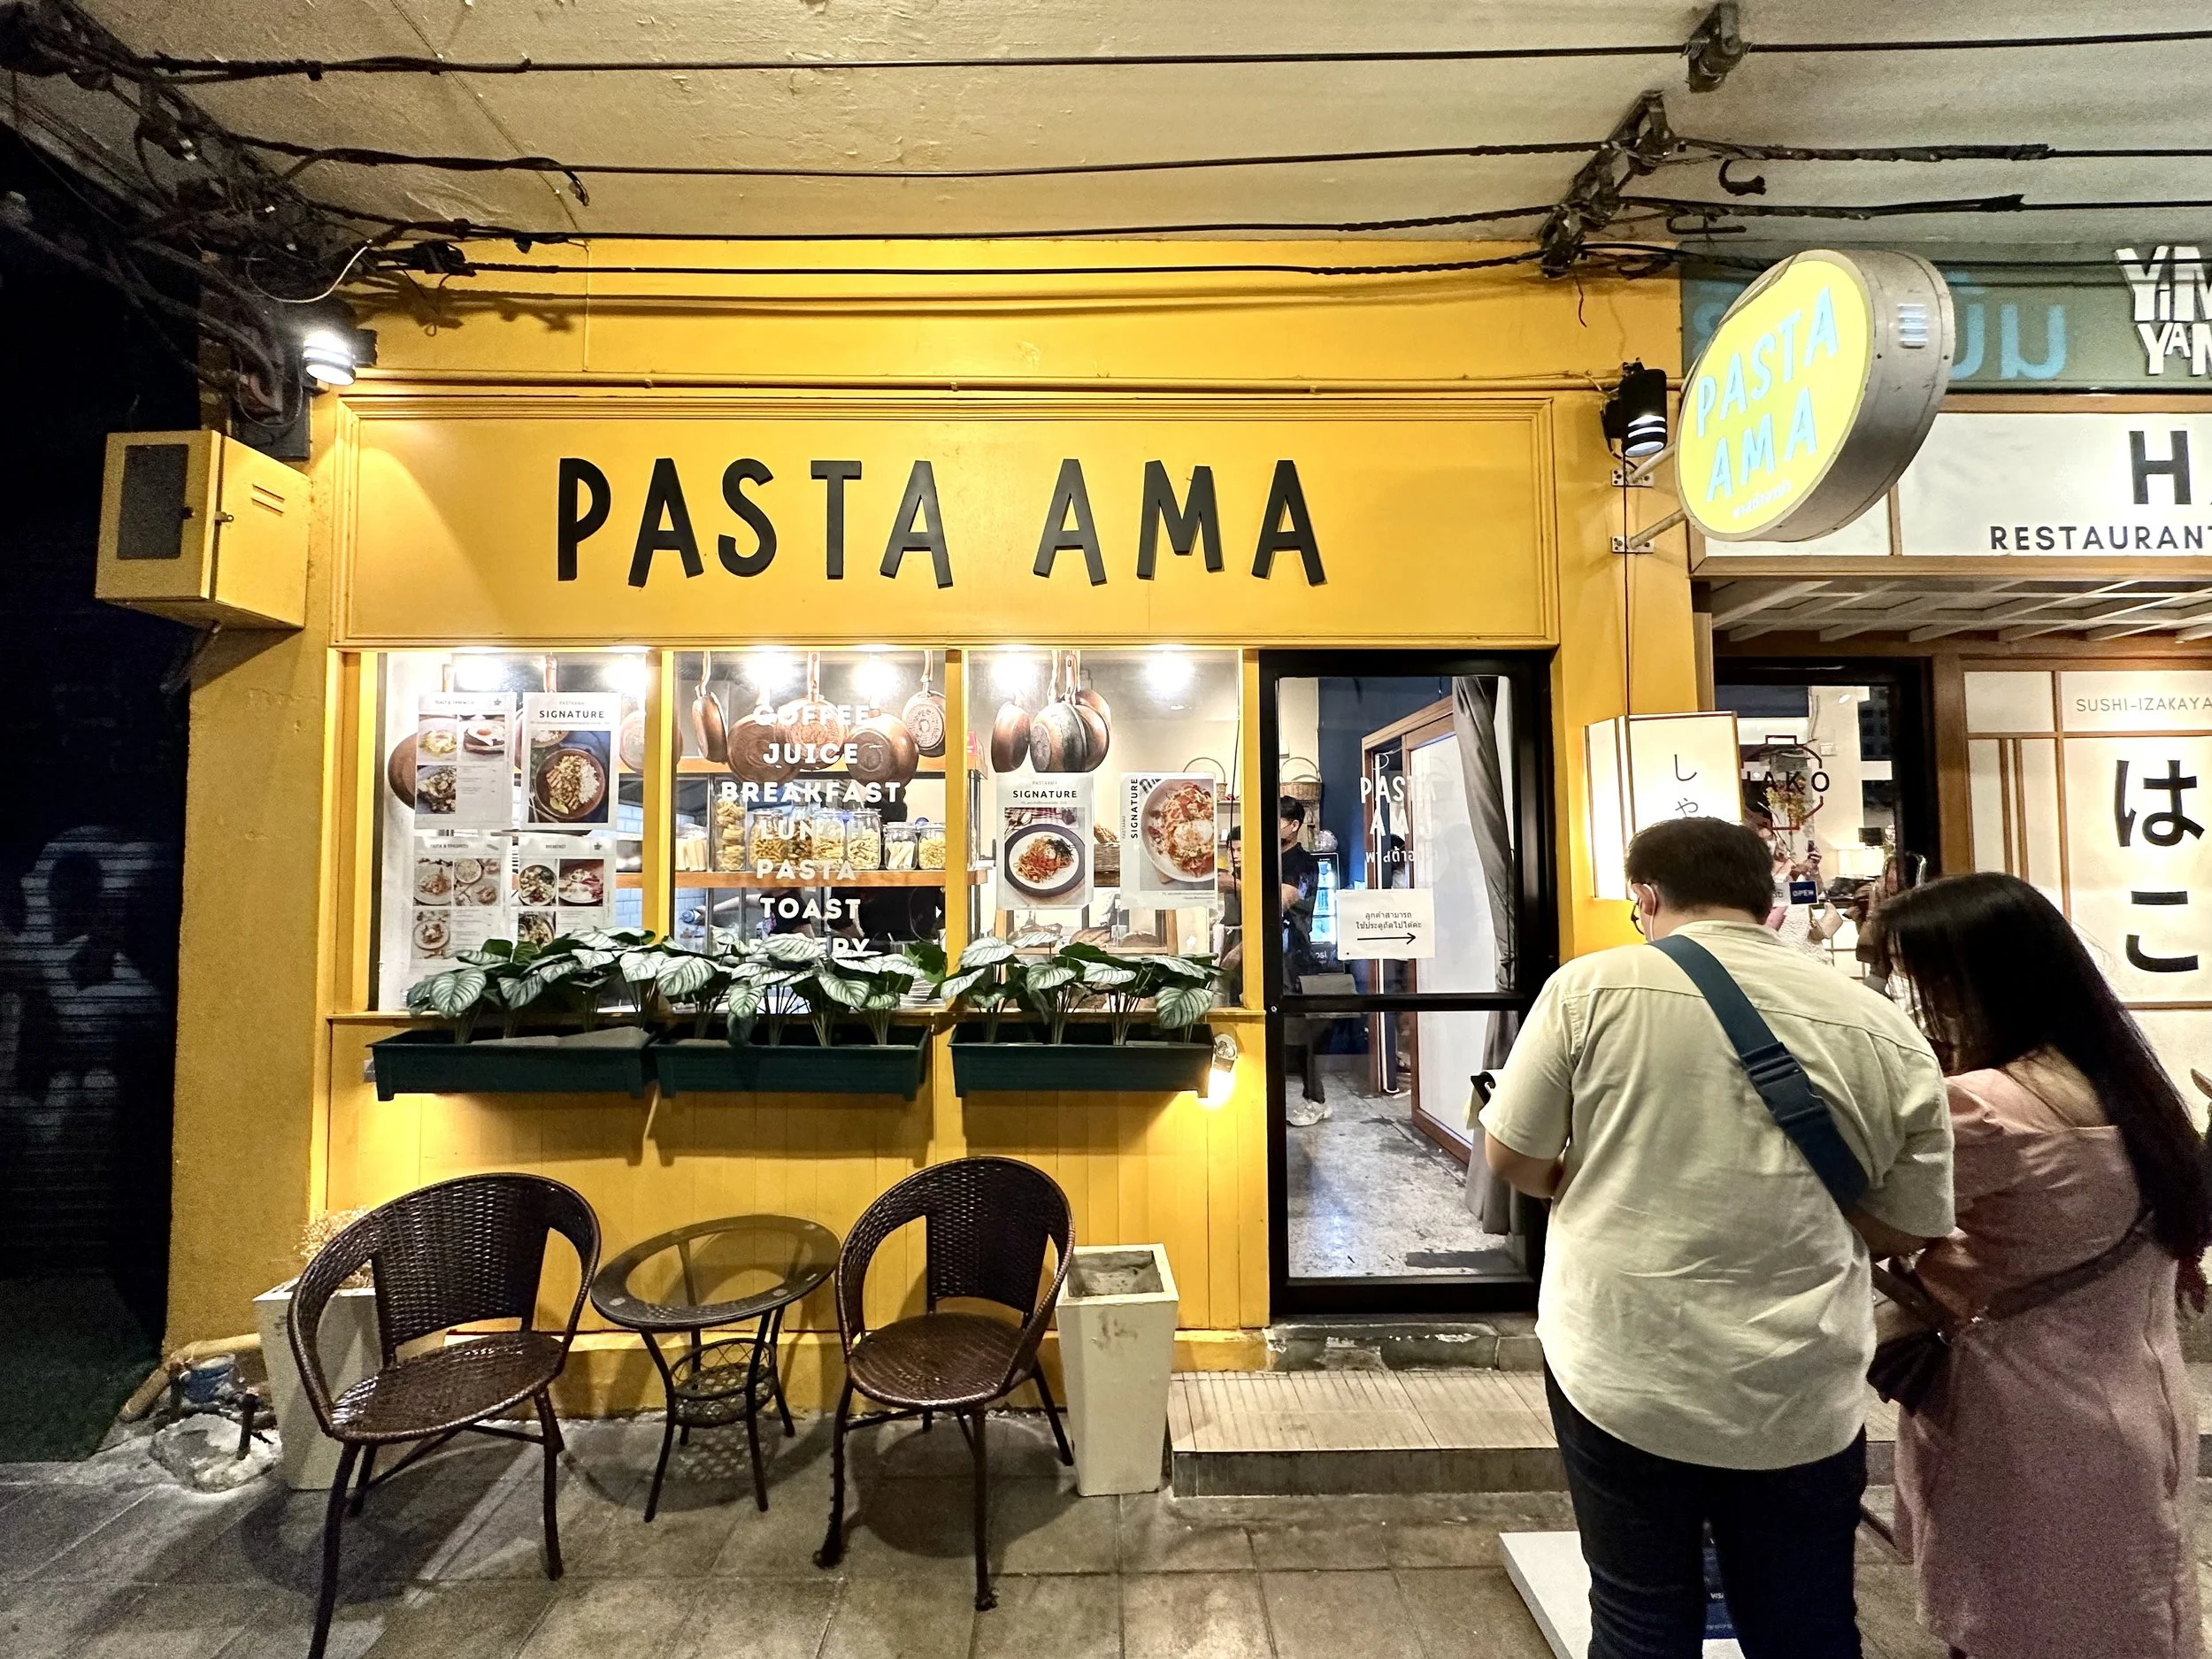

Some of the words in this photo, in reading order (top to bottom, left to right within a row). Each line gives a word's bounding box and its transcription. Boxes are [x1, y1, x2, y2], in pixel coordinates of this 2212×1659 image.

[1696, 285, 1839, 438] PASTA
[1705, 387, 1818, 503] AMA
[2129, 431, 2212, 505] H
[558, 457, 954, 588] PASTA
[1032, 457, 1329, 587] AMA
[1990, 526, 2212, 550] RESTAURAN
[539, 710, 604, 718] SIGNATURE
[2076, 696, 2212, 712] SUSHI-IZAKAYA
[753, 705, 870, 726] COFFEE
[763, 742, 858, 764] JUICE
[721, 782, 902, 803] BREAKFAST
[1360, 775, 1436, 803] PAS
[760, 819, 864, 840] LUNCH
[757, 858, 856, 880] PASTA
[2115, 759, 2205, 973] はこ
[759, 897, 861, 919] TOAST
